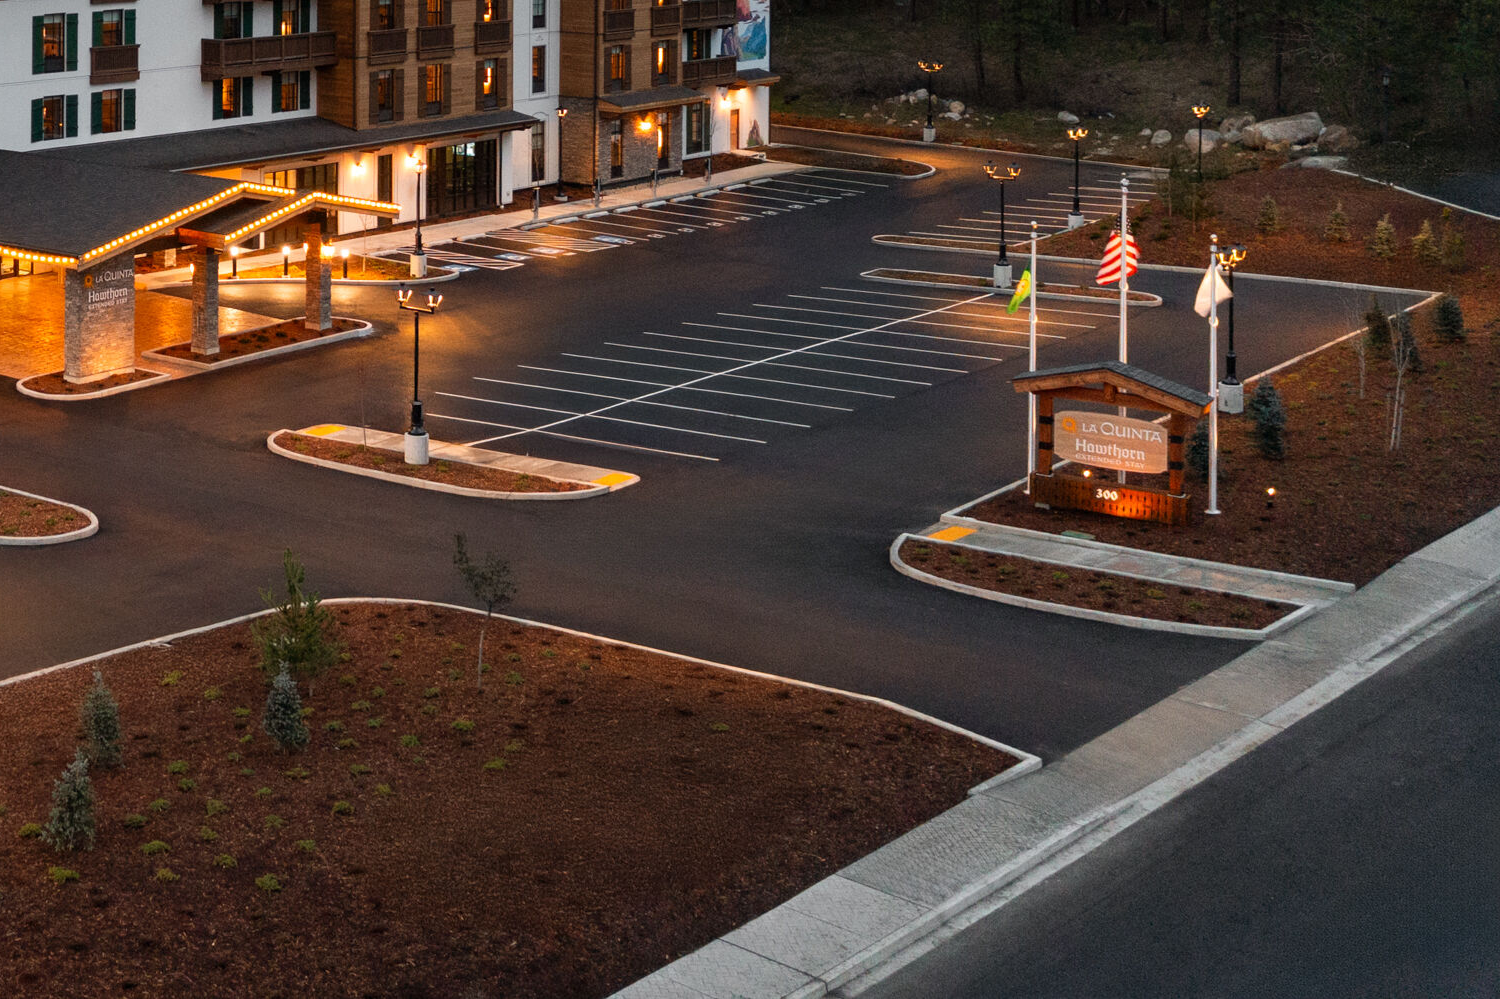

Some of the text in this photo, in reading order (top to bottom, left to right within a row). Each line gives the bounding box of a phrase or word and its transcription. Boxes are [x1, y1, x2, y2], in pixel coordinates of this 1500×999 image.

[1082, 422, 1162, 443] LA QUINTA
[1075, 438, 1146, 460] Hawthorn
[1075, 453, 1146, 469] EXTENDED STAY
[1095, 488, 1118, 501] 300
